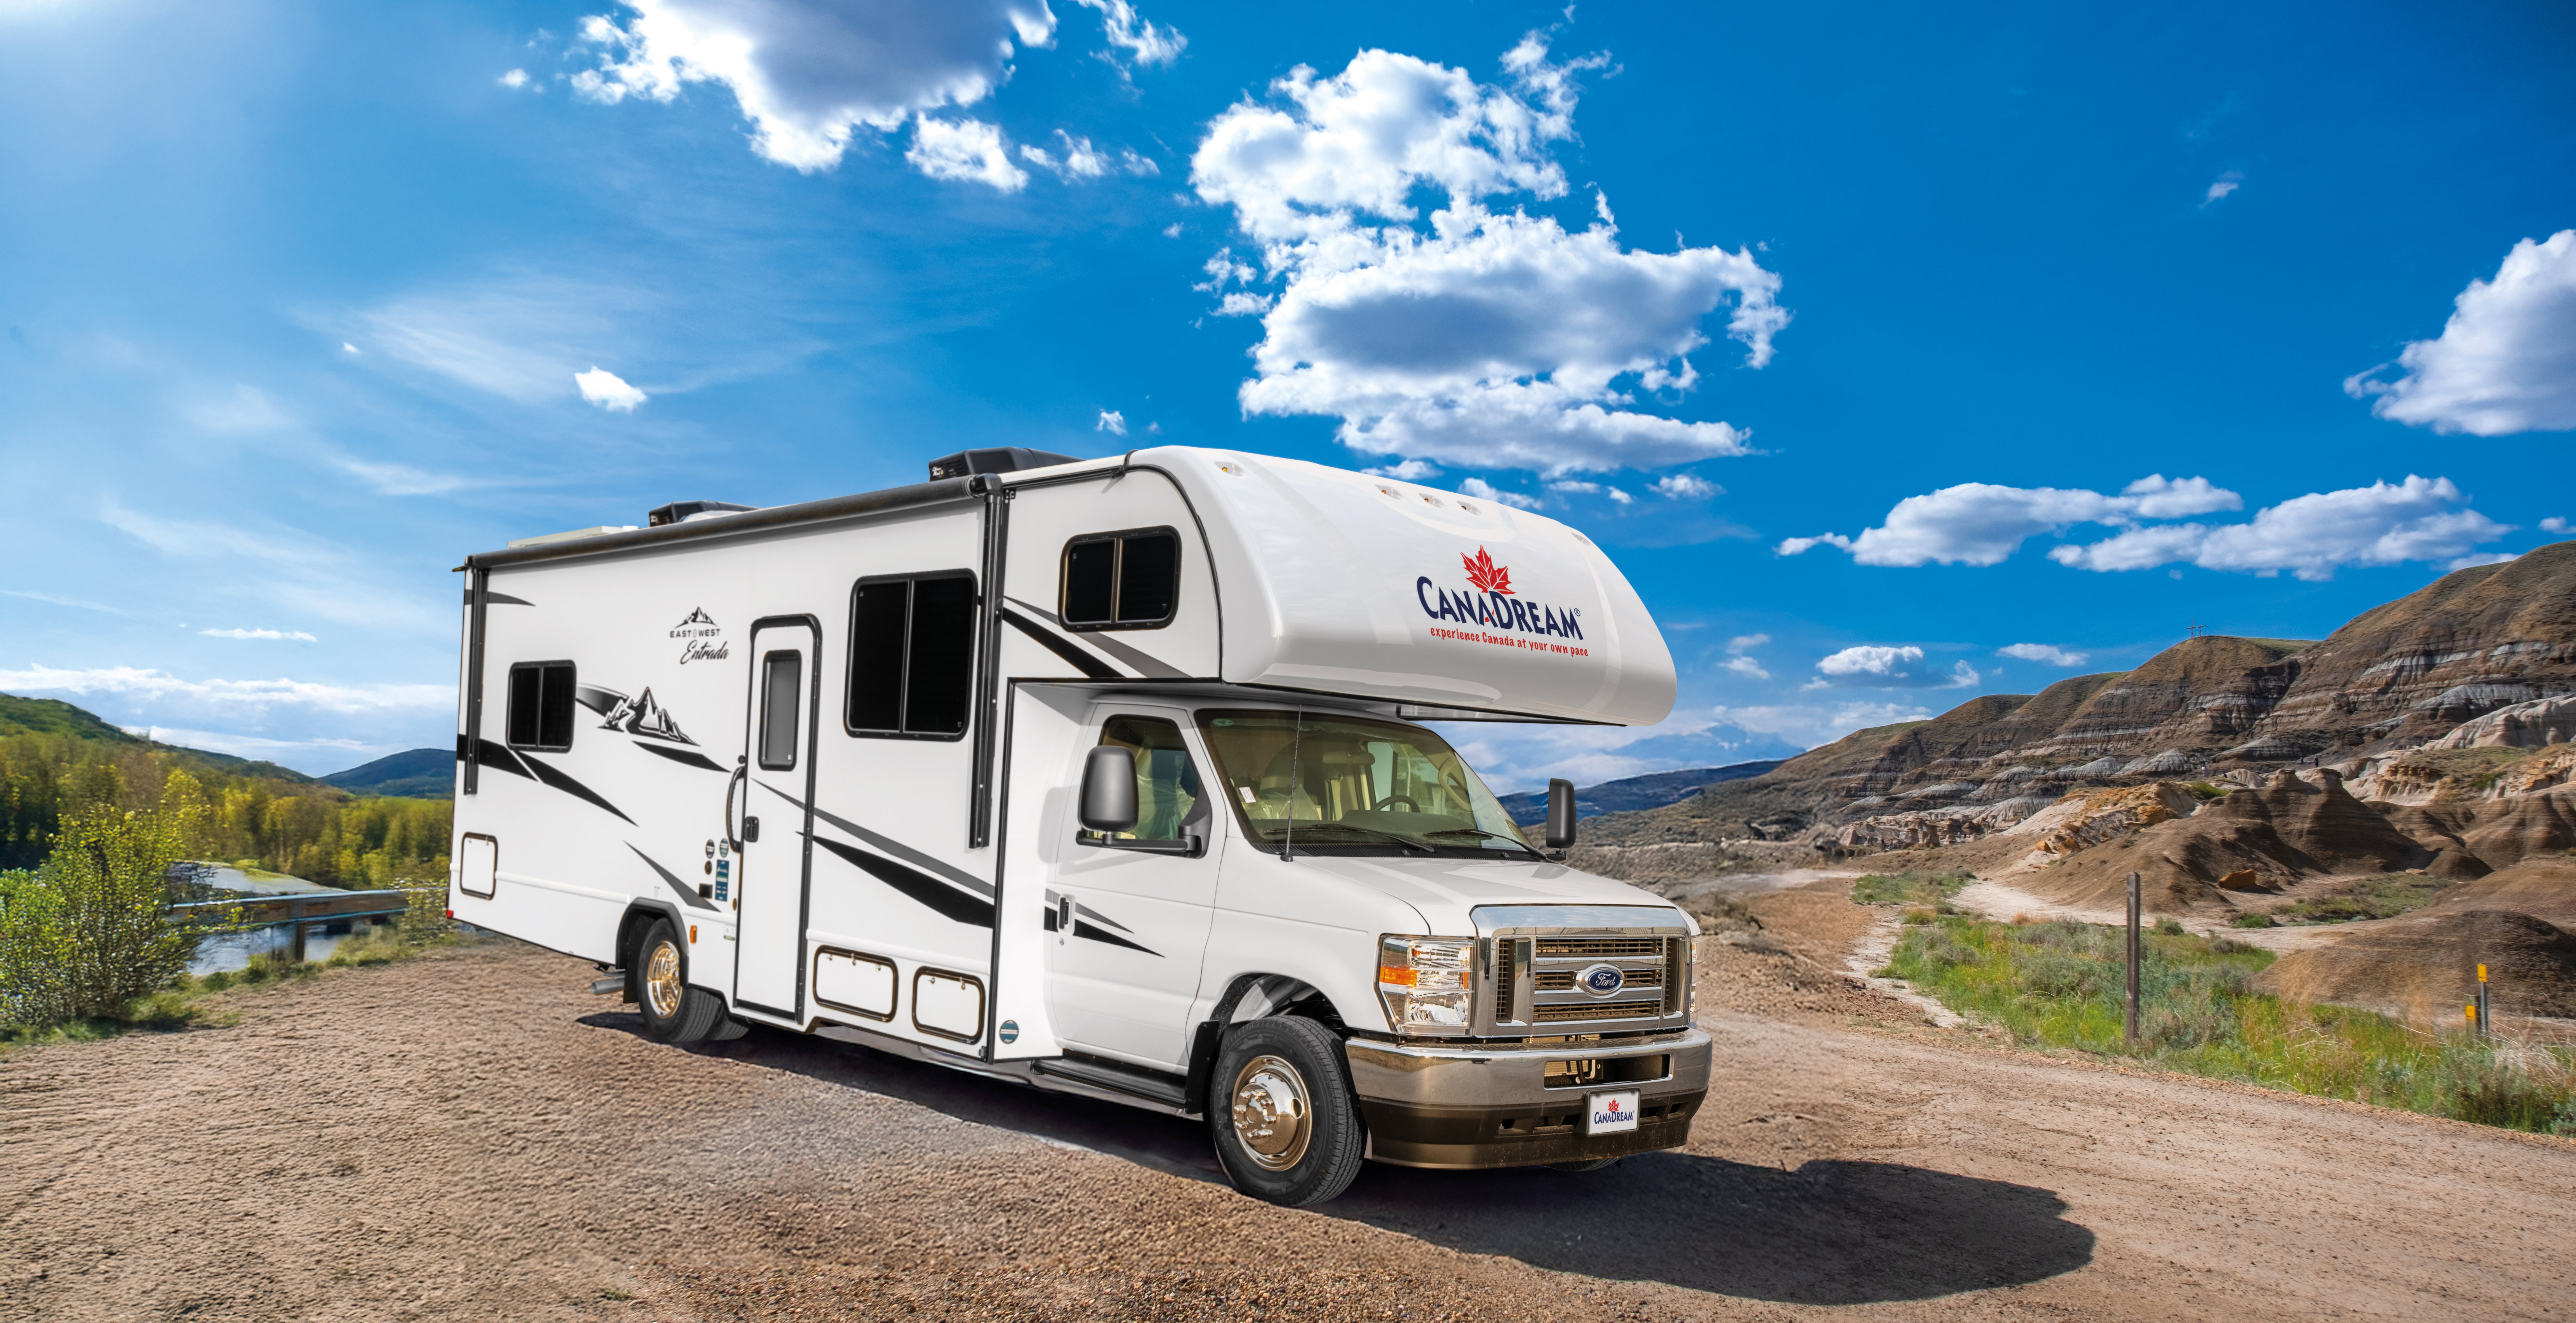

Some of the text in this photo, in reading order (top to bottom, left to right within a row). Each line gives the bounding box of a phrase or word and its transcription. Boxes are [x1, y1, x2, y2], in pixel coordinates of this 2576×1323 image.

[698, 629, 721, 637] WEST
[1431, 628, 1588, 657] experience Canada at your own pace
[680, 640, 729, 665] Entrada
[1596, 973, 1616, 986] Ford
